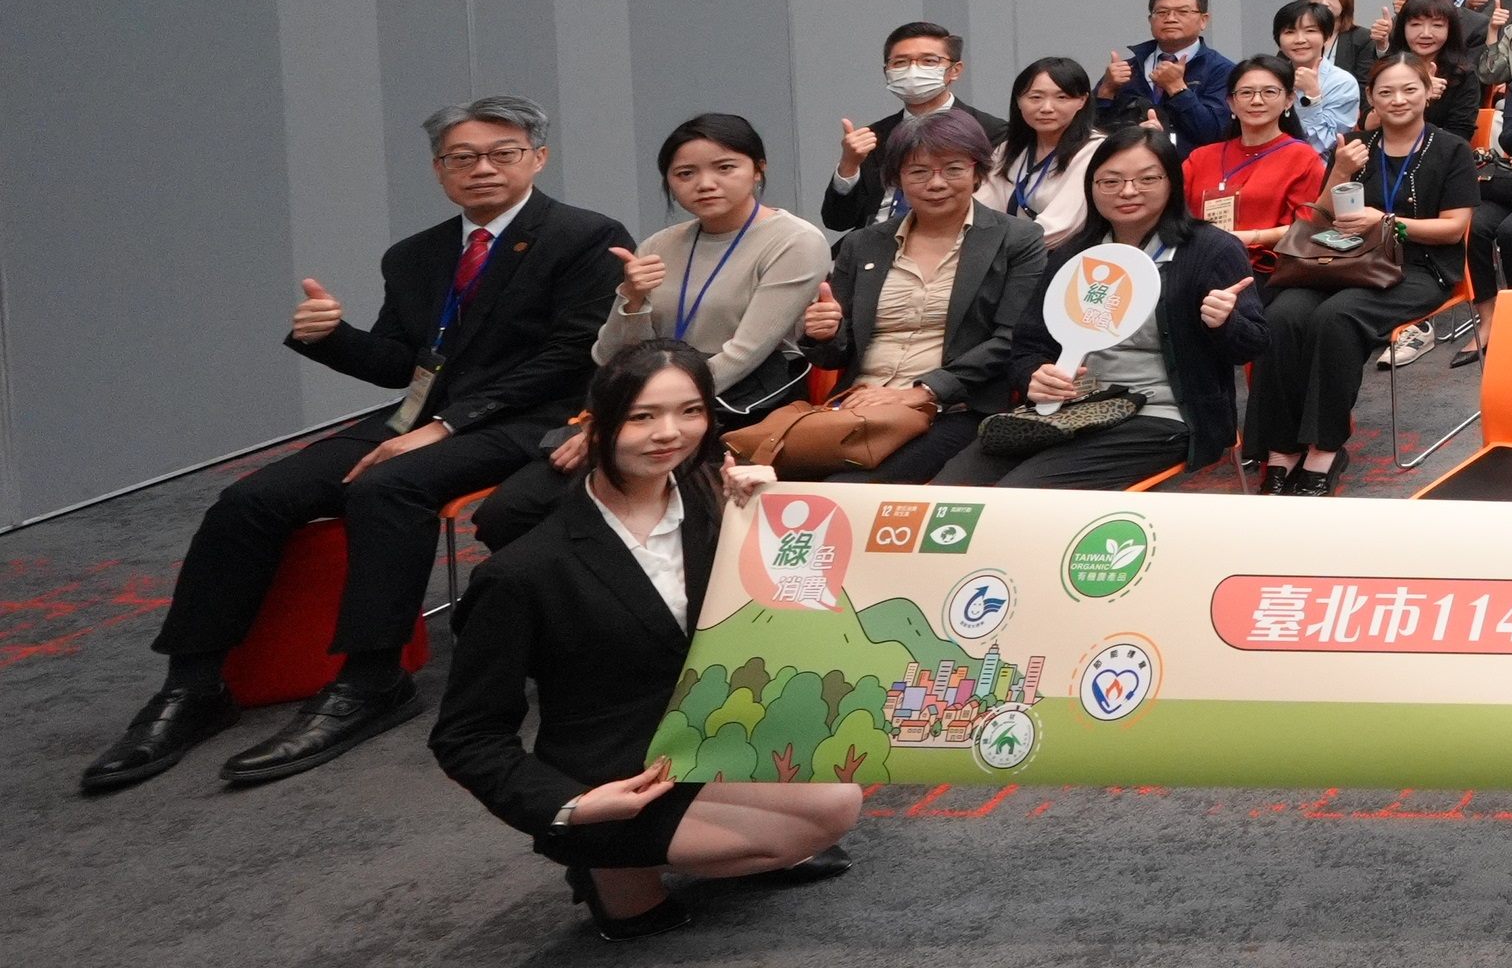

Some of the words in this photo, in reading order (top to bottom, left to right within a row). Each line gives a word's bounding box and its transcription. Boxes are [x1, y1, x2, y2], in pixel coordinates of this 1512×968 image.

[1084, 283, 1120, 311] 綠色
[881, 504, 893, 517] 12
[936, 506, 948, 518] 13
[772, 532, 836, 570] 綠色
[1074, 553, 1112, 562] TAIWAN
[771, 575, 827, 602] 消費
